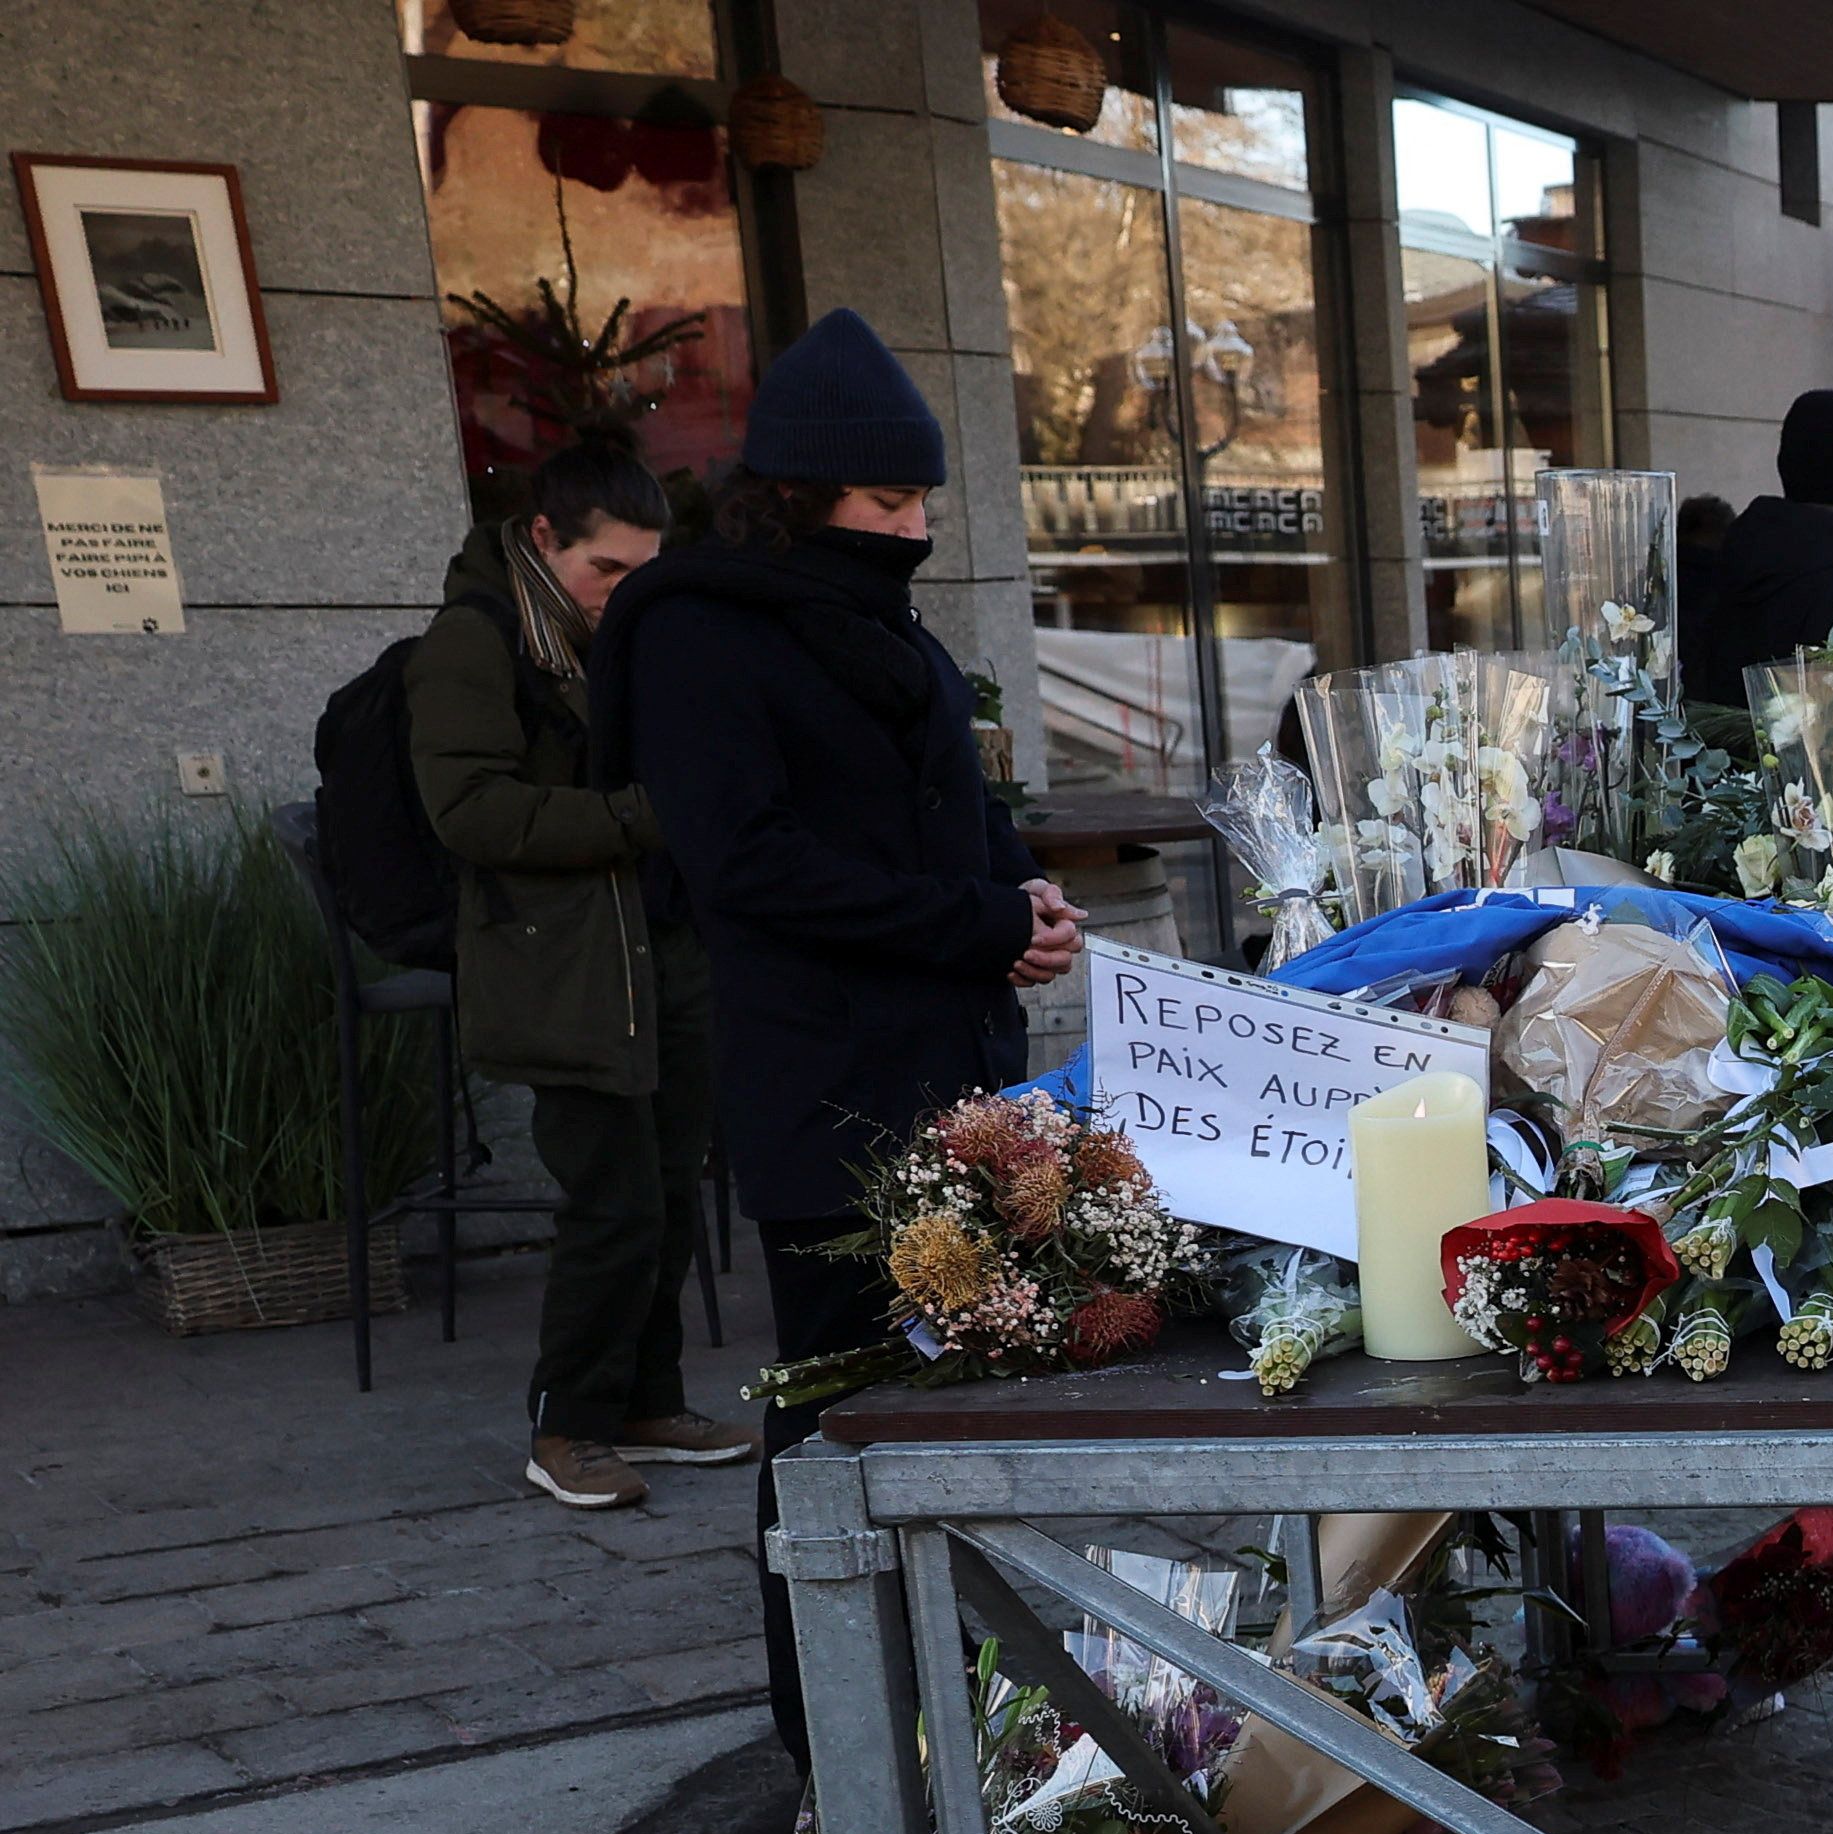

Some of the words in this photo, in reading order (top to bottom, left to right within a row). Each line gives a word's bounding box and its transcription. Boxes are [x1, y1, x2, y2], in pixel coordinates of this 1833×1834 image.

[47, 522, 108, 533] MERCI
[111, 523, 135, 533] DE
[139, 523, 164, 534] NE
[61, 538, 99, 548] PAS
[102, 538, 156, 549] FAIRE
[56, 553, 110, 563] FAIRE
[114, 554, 150, 564] PIPI
[61, 568, 97, 578] VOS
[101, 568, 168, 579] CHIENS
[105, 584, 130, 593] ICI
[1115, 973, 1351, 1063] REPOSEZ
[1373, 1044, 1432, 1072] EN
[1135, 1092, 1222, 1141] DES
